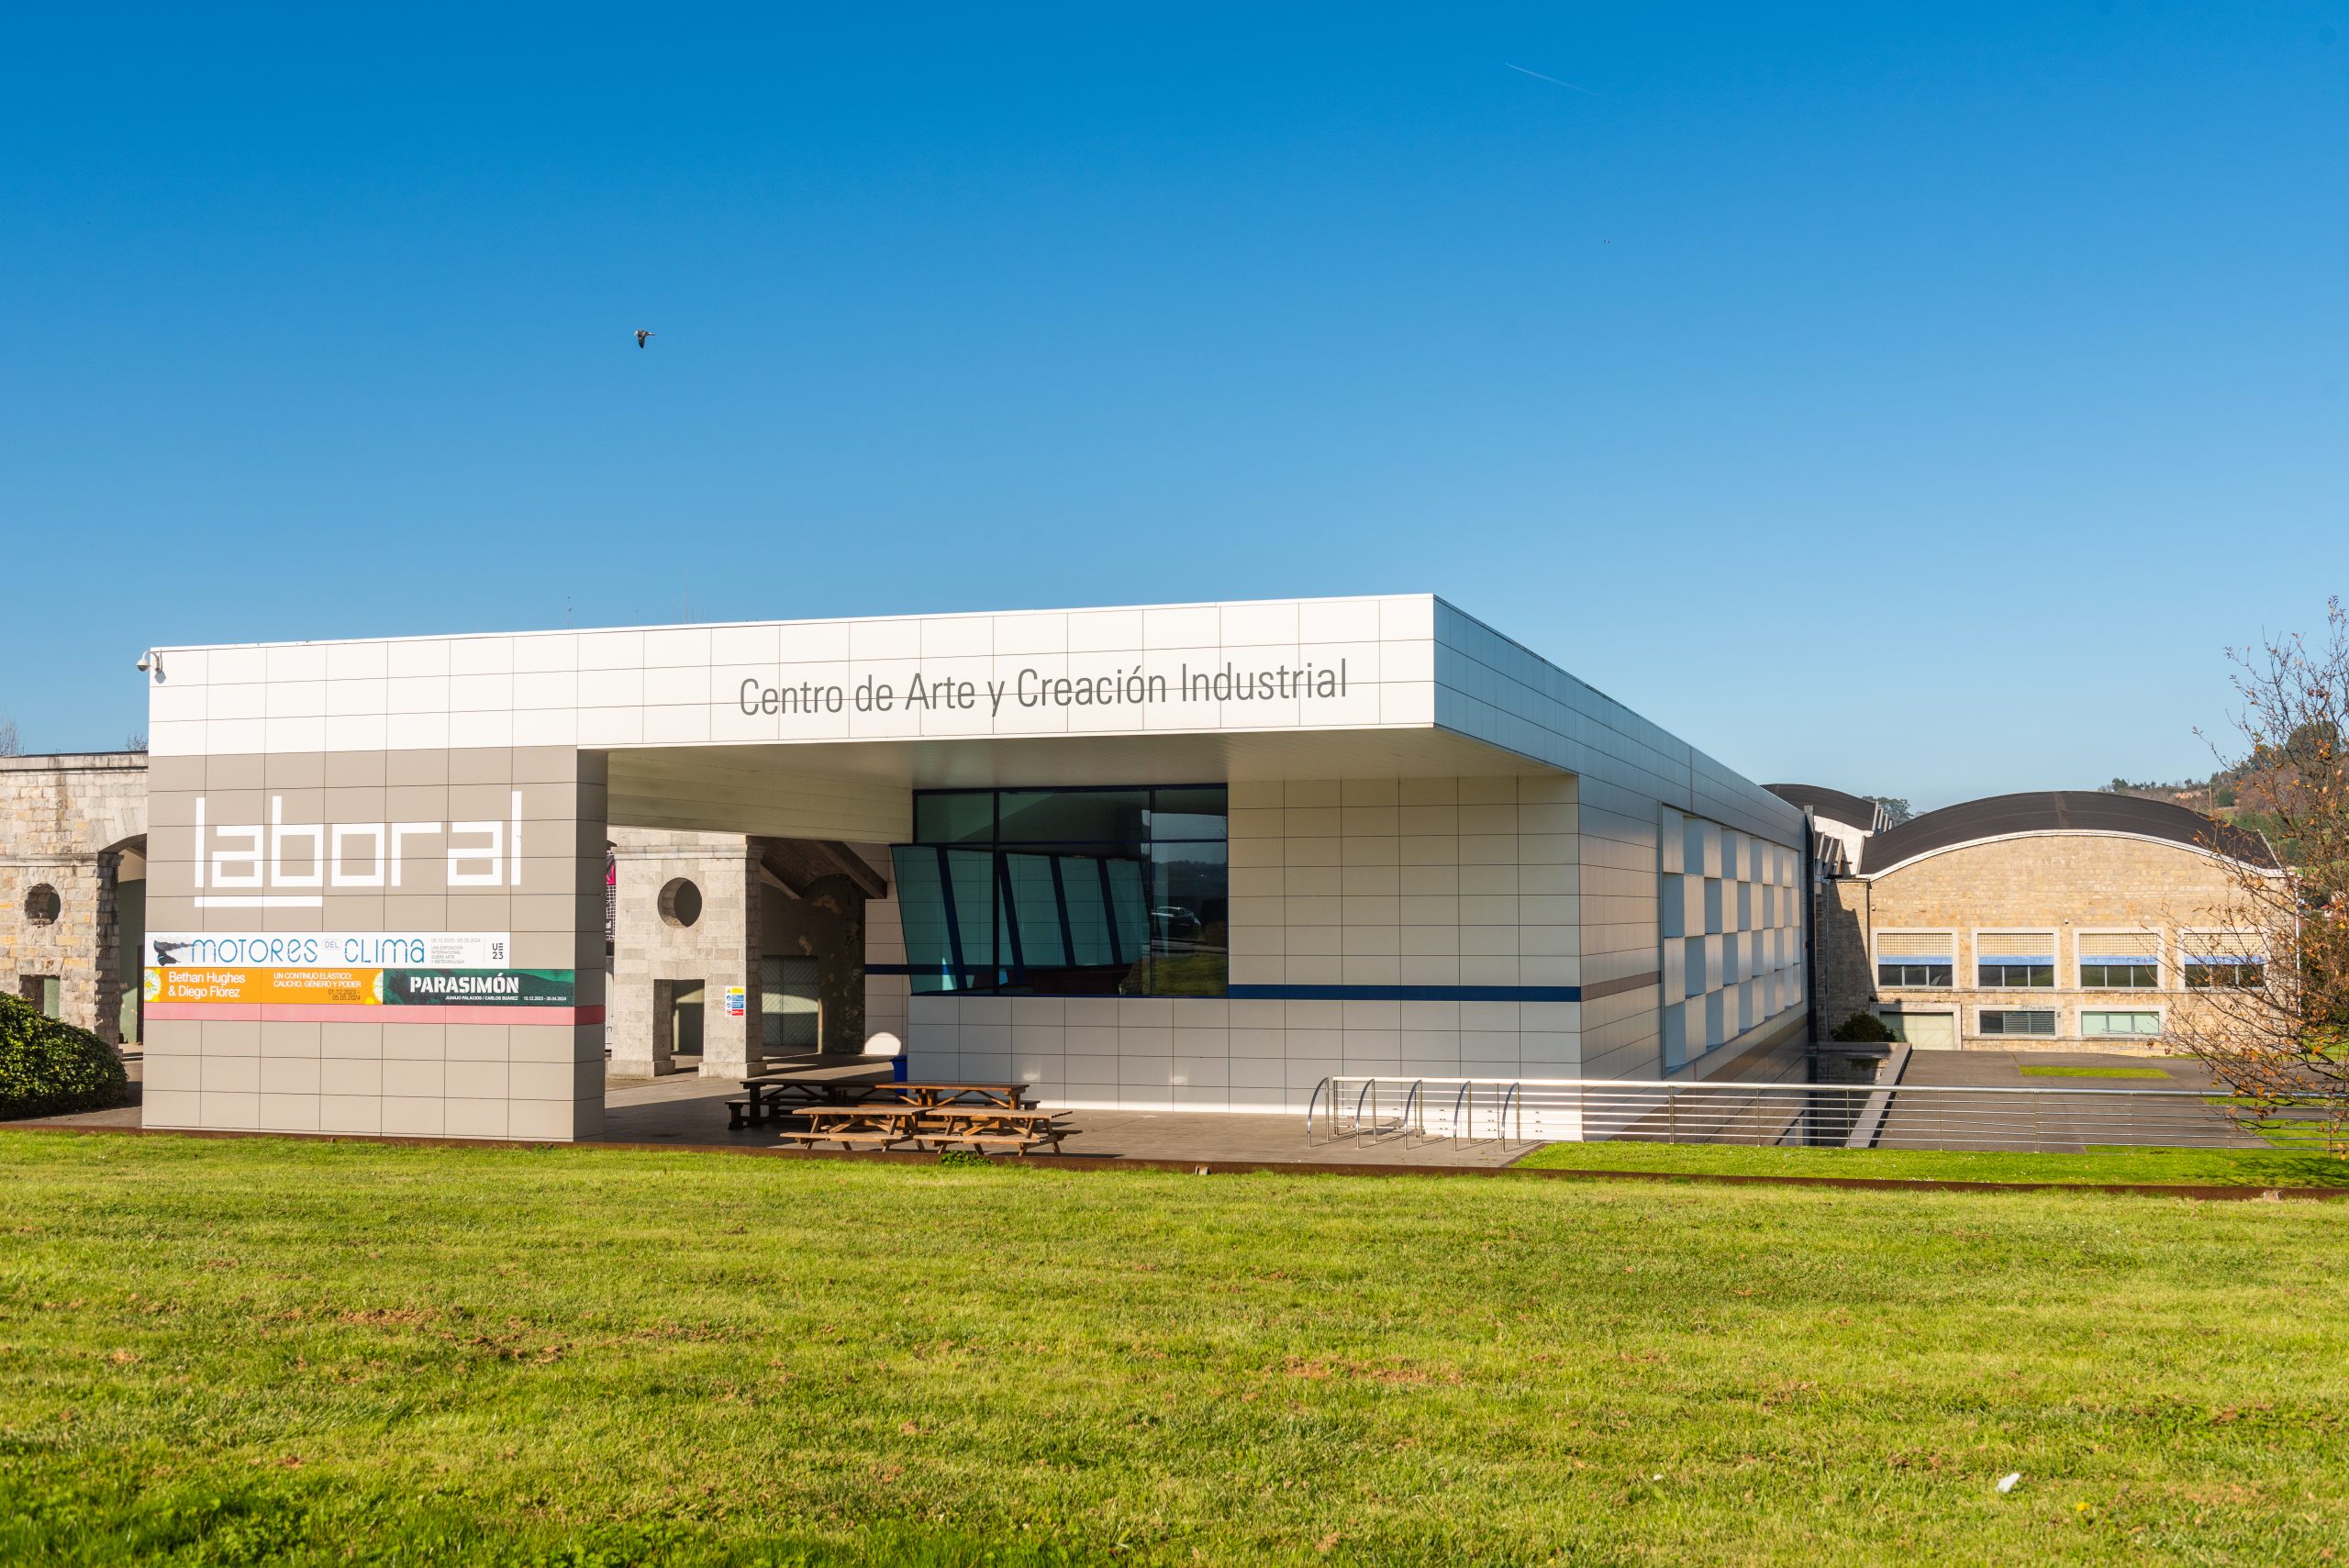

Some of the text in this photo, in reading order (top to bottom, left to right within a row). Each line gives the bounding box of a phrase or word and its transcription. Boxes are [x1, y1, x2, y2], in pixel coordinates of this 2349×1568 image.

[740, 659, 1347, 717] Centro de Arte y Creación Industrial
[324, 940, 340, 949] DEL
[492, 951, 504, 960] 23
[168, 971, 246, 986] Bethan Hughes
[305, 979, 331, 987] GÉNERO
[410, 973, 519, 994] PARASIMÓN
[168, 984, 240, 1000] & Diego Flórez
